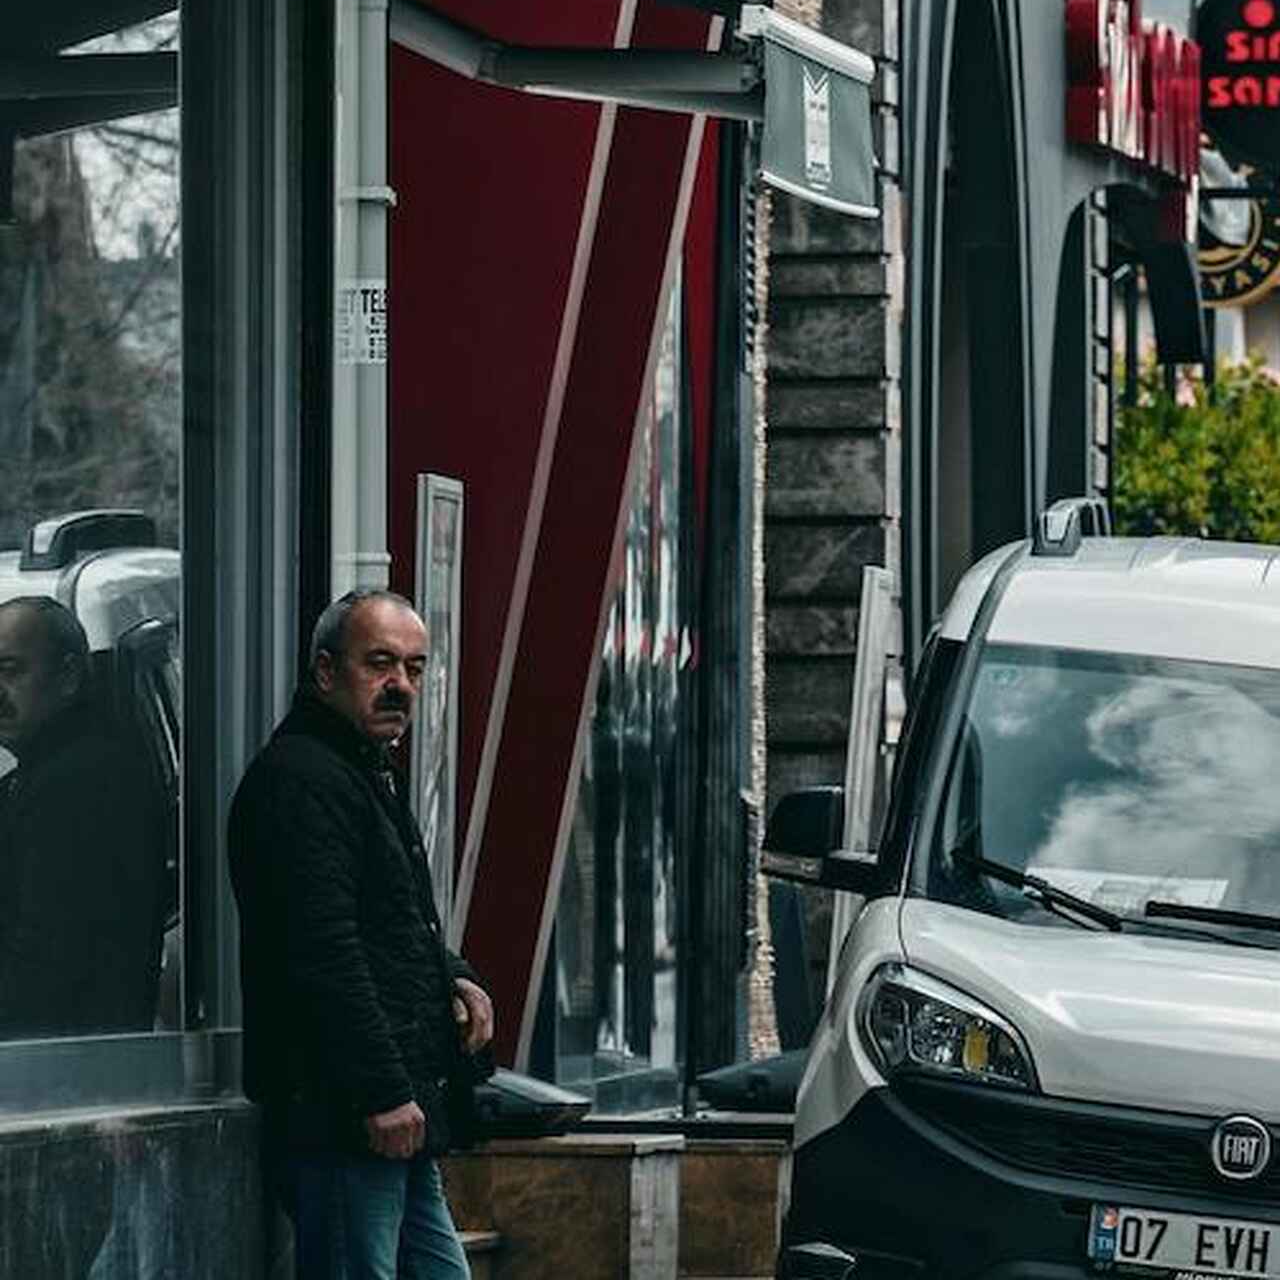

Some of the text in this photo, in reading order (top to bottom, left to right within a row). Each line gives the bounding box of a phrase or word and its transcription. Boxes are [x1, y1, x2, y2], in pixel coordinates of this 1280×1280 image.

[1223, 1133, 1260, 1166] FIAT
[1119, 1215, 1168, 1261] 07
[1194, 1222, 1271, 1273] EVH
